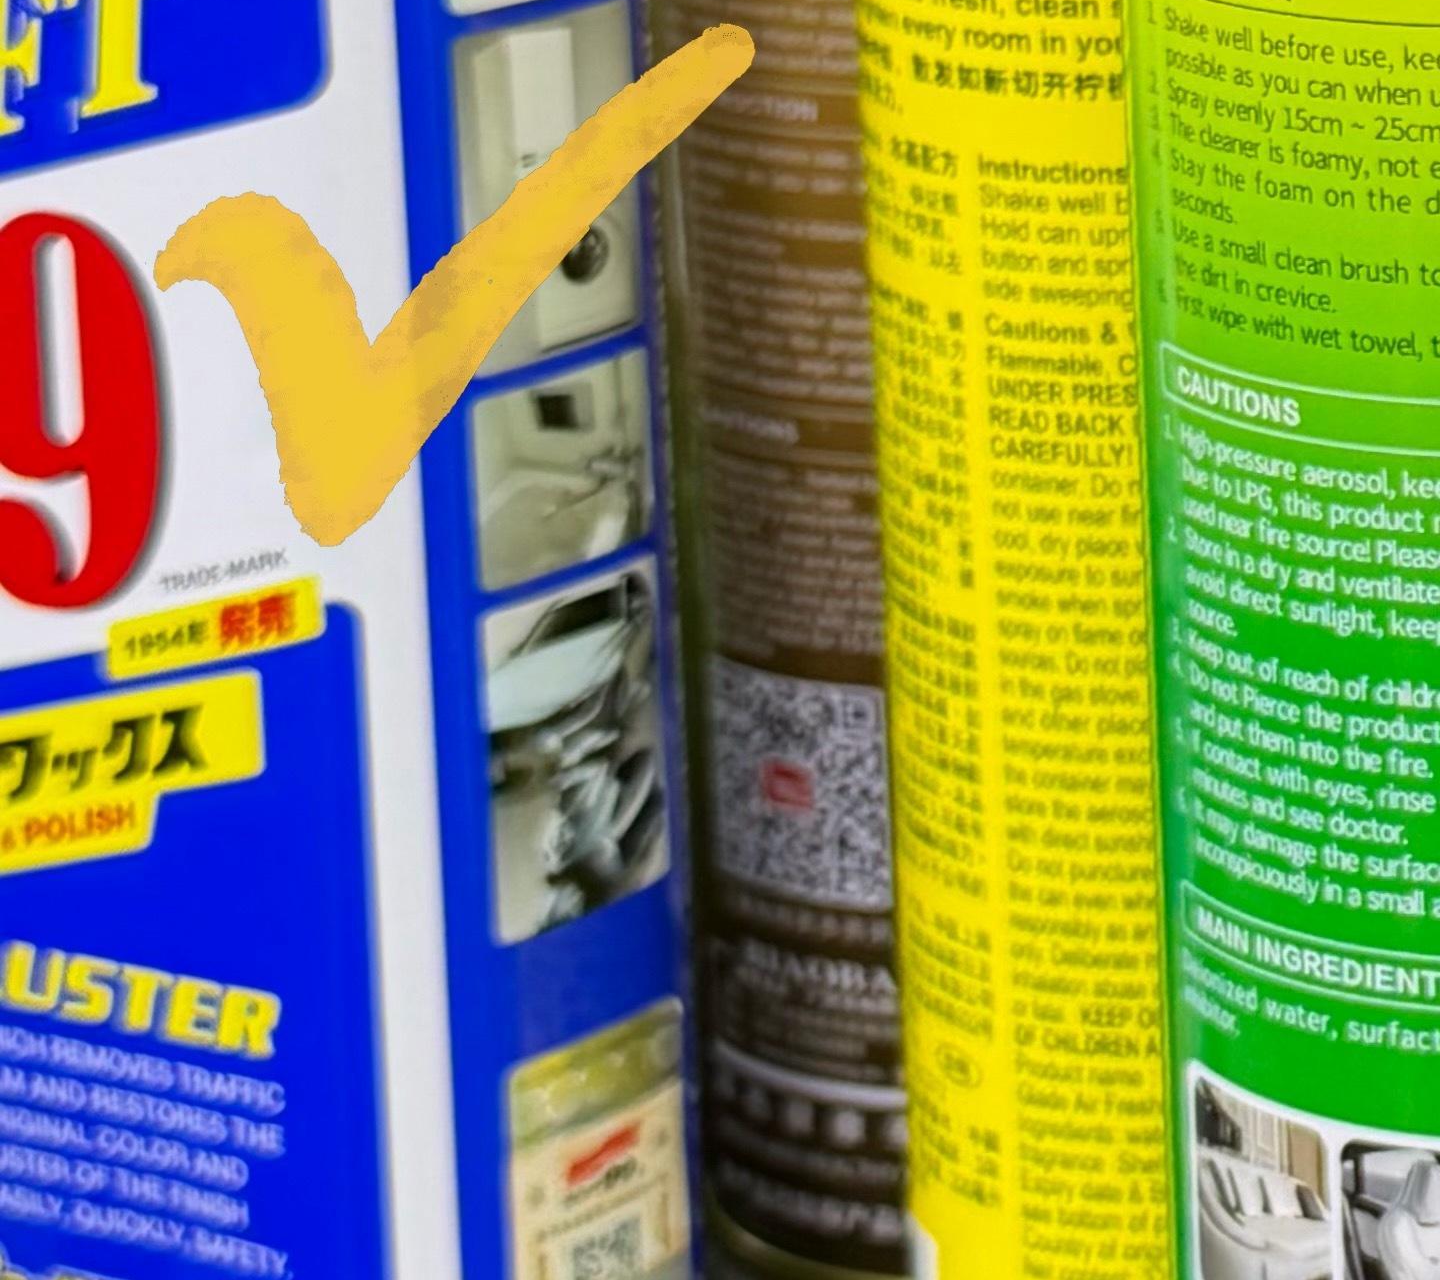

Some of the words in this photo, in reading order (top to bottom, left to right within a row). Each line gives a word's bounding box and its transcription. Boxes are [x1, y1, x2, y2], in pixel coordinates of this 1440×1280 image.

[963, 24, 1031, 54] room
[1043, 27, 1067, 55] in
[1215, 26, 1252, 52] well
[1261, 31, 1334, 64] before
[1344, 49, 1393, 73] use,
[979, 182, 1050, 212] Shake
[1058, 193, 1107, 216] well
[1255, 170, 1312, 204] foam
[1324, 189, 1354, 208] on
[1367, 188, 1411, 213] the
[981, 214, 1031, 243] Hold
[1037, 225, 1080, 244] can
[1048, 254, 1087, 276] and
[984, 312, 1090, 344] Cautions
[988, 375, 1064, 404] UNDER
[1177, 367, 1300, 427] CAUTIONS
[989, 405, 1050, 434] READ
[1055, 412, 1124, 437] BACK
[1284, 492, 1323, 520] this
[1329, 505, 1424, 533] product
[24, 800, 137, 848] POLISH
[1199, 906, 1250, 956] MAIN
[0, 940, 283, 1059] USTER
[1265, 1000, 1338, 1040] water,
[50, 1033, 174, 1092] REMOVES
[174, 1061, 286, 1118] TRAFFIC
[30, 1071, 87, 1113] AND
[88, 1081, 228, 1146] RESTORES
[228, 1114, 286, 1159] THE
[94, 1123, 190, 1171] COLOR
[190, 1146, 249, 1192] AND
[72, 1158, 110, 1195] OF
[113, 1167, 170, 1205] THE
[168, 1177, 250, 1232] FINISH
